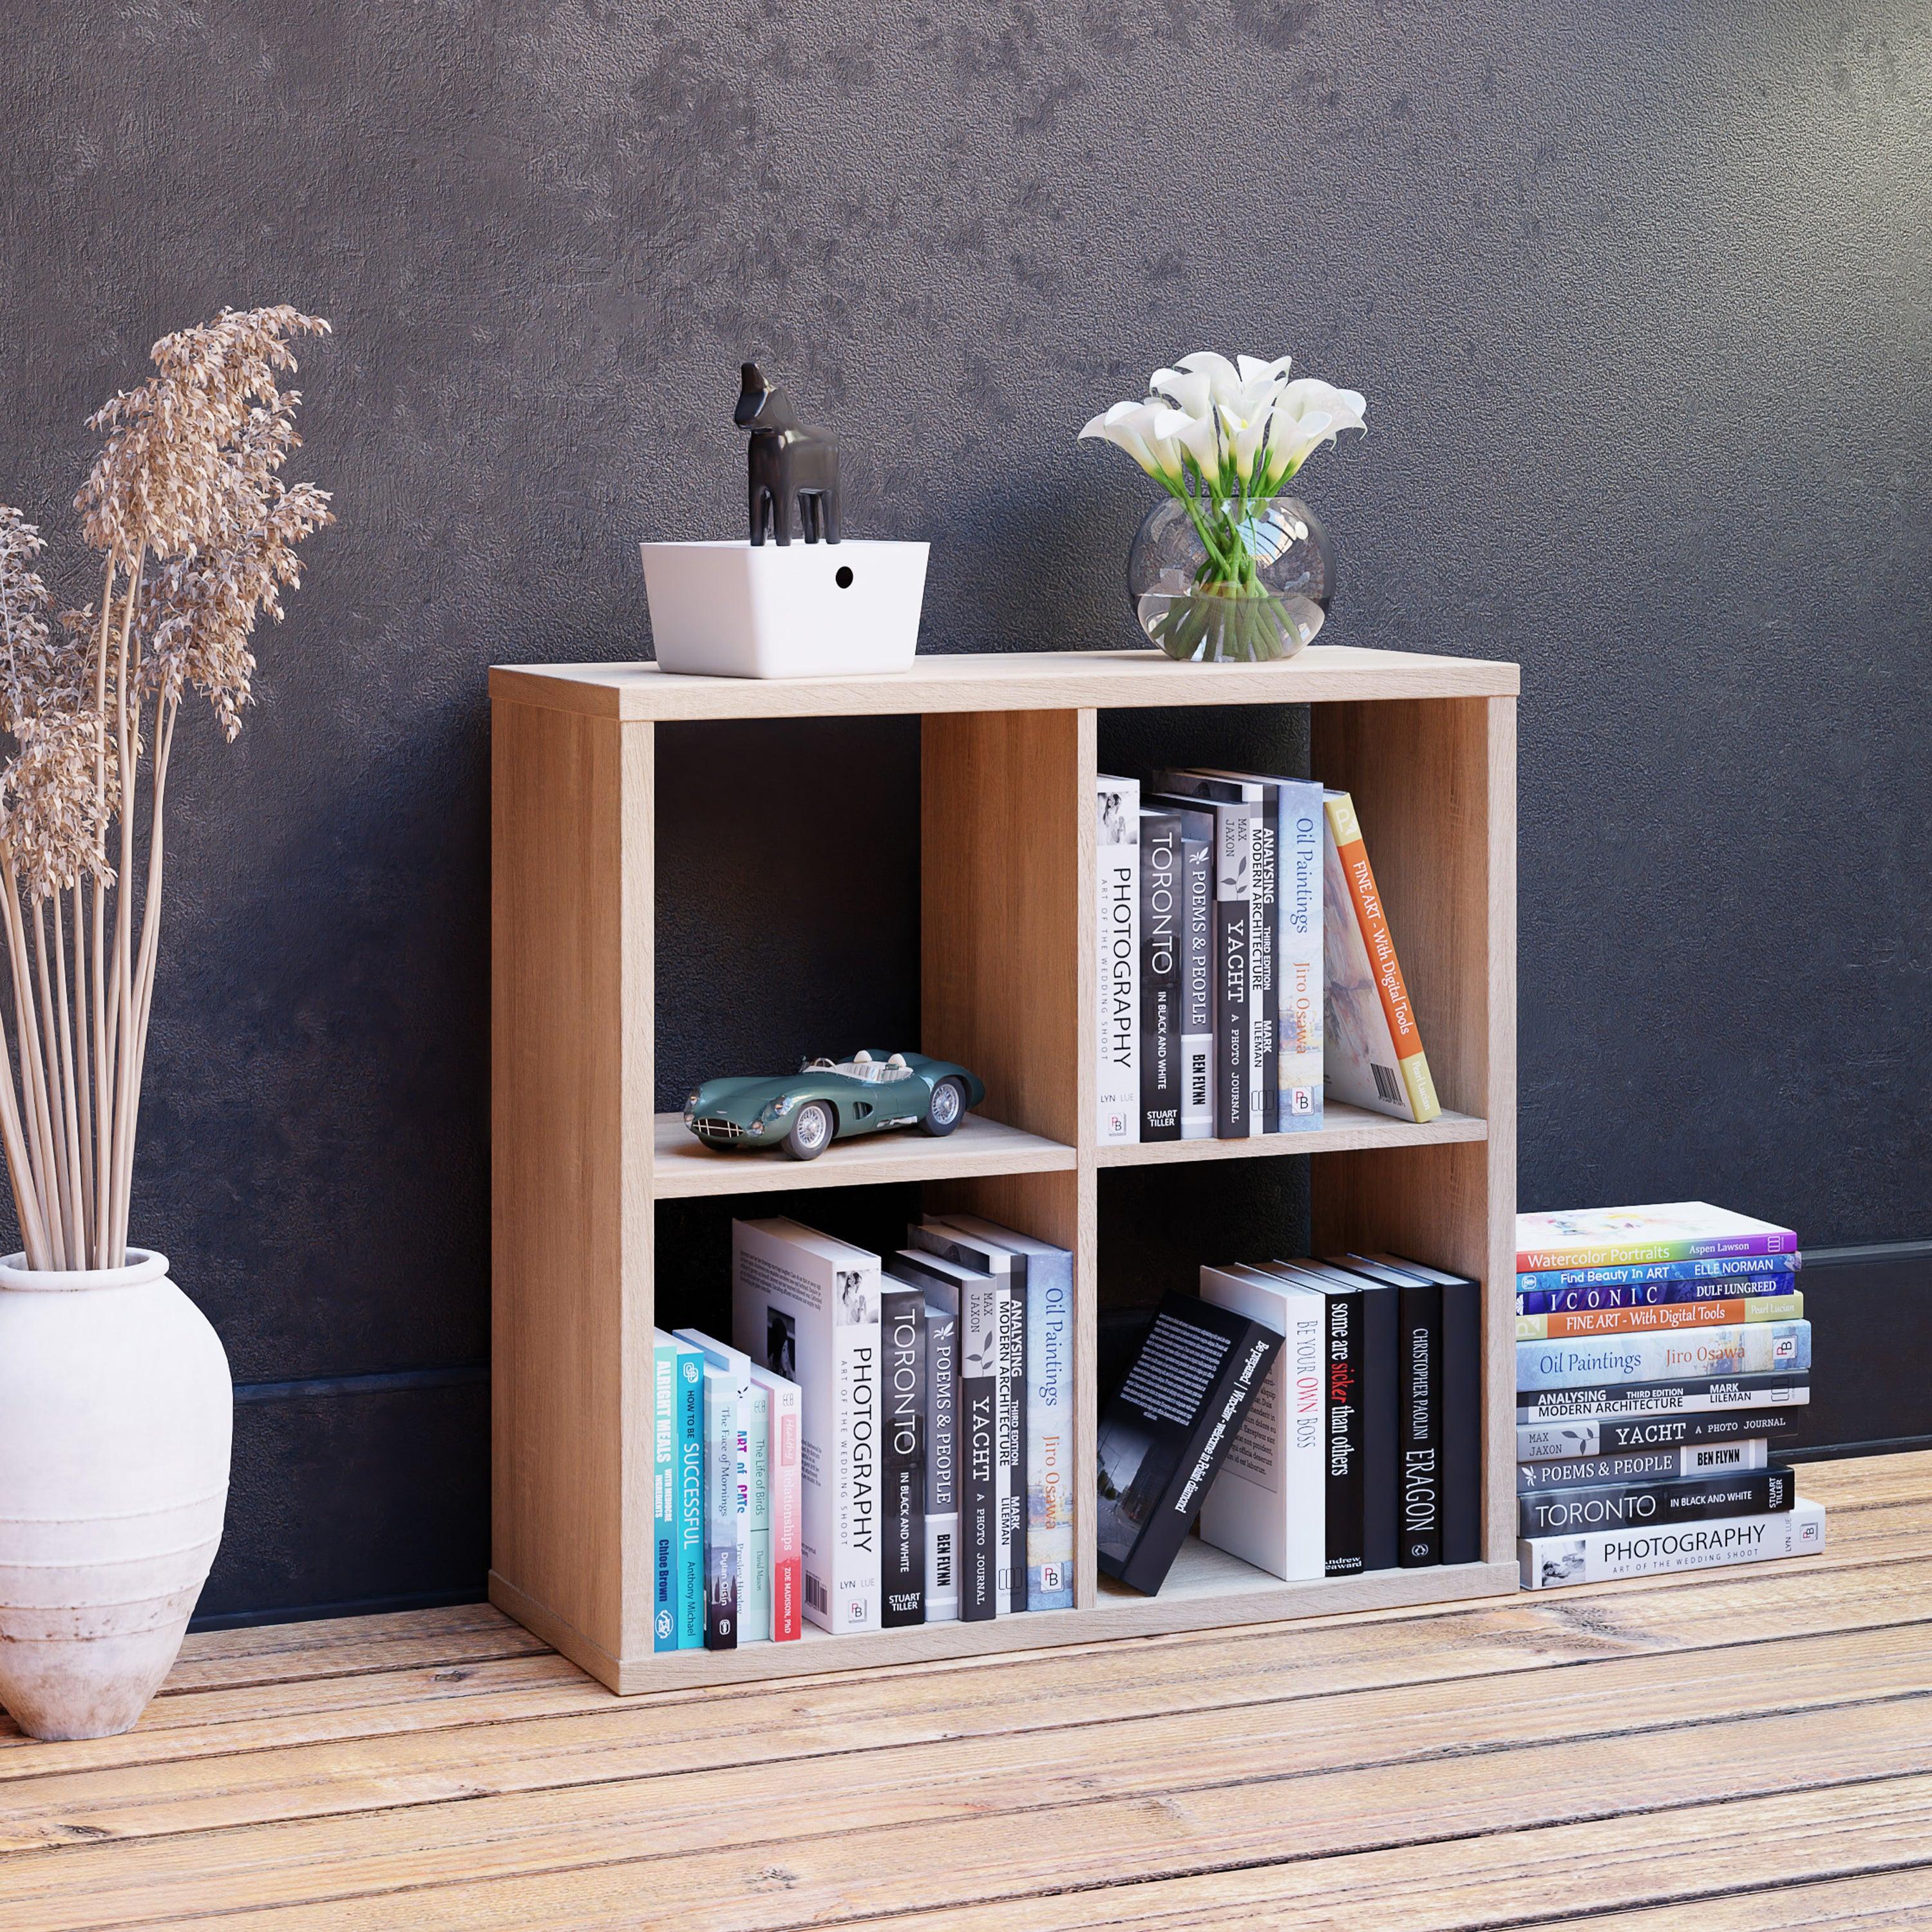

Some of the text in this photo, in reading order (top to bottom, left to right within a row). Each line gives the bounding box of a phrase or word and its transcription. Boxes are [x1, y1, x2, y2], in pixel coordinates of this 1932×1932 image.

[1226, 819, 1235, 857] JAXON
[1238, 818, 1247, 841] MAX
[1263, 828, 1274, 904] ANALYSING
[1290, 818, 1315, 934] Oil Paintings
[1151, 832, 1172, 974] TORONTO
[1253, 829, 1262, 990] MODERN ARCHITECTURE
[1192, 870, 1206, 1025] POEMS PEOPLE
[1227, 919, 1244, 1003] YACHT
[1263, 926, 1271, 990] THIRD EDITION
[1353, 860, 1414, 1035] FINE ART With Digital Tools
[1113, 868, 1131, 1068] PHOTOGRAPHY
[1293, 962, 1310, 1054] Jiro Osawa
[1158, 1004, 1166, 1090] BLACK AND WHITE
[1254, 1021, 1262, 1068] LILEMAN
[1263, 1020, 1272, 1053] MARK
[1193, 1054, 1206, 1105] BEN FLYNN
[1231, 1029, 1239, 1123] PHOTO JOURNAL
[1147, 1110, 1177, 1119] STUART
[1150, 1118, 1175, 1126] TILLER
[1528, 1246, 1670, 1268] Watercolor Portraits
[1689, 1242, 1749, 1255] Aspen Lawson
[1694, 1259, 1773, 1276] ELLE NORMAN
[1560, 1267, 1669, 1284] Find Beauty ART
[1696, 1281, 1776, 1297] DULF LUNGREED
[971, 1294, 980, 1333] JAXON
[984, 1293, 992, 1316] MAX
[1566, 1303, 1725, 1331] FINE ART With Digital Tools
[1011, 1300, 1022, 1378] ANALYSING
[1039, 1288, 1065, 1406] Oil Paintings
[1666, 1347, 1745, 1367] Jiro Osawa
[894, 1308, 916, 1455] TORONTO
[1239, 1347, 1262, 1385] prepared
[1540, 1352, 1642, 1374] Oil Paintings
[999, 1301, 1010, 1466] MODERN ARCHITECTURE
[1297, 1320, 1318, 1448] BE YOUR OWN BOSS
[1331, 1303, 1357, 1476] some are sicker than others
[1413, 1328, 1428, 1439] CHRISTOPHER PAOLINI
[1538, 1390, 1606, 1405] ANALYSING
[1626, 1388, 1683, 1399] THIRD EDITION
[1710, 1383, 1739, 1394] MARK
[1710, 1392, 1751, 1403] LILEMAN
[656, 1361, 671, 1463] ALRIGHT MEALS
[936, 1346, 951, 1504] POEMS PEOPLE
[1539, 1397, 1683, 1417] MODERN ARCHITECTURE
[1708, 1417, 1786, 1432] PHOTO JOURNAL
[784, 1419, 795, 1459] Healthy
[853, 1348, 871, 1552] PHOTOGRAPHY
[972, 1396, 990, 1481] YACHT
[1204, 1422, 1226, 1460] welcome
[1244, 1425, 1267, 1441] Excepteur
[1529, 1432, 1549, 1443] MAX
[1530, 1444, 1562, 1456] JAXON
[1615, 1423, 1686, 1445] YACHT
[719, 1431, 730, 1517] Face Mornings
[1190, 1460, 1210, 1486] Polish
[1253, 1452, 1273, 1466] deserunt
[1541, 1455, 1672, 1482] POEMS PEOPLE
[1697, 1449, 1739, 1466] BEN FLYNN
[684, 1443, 699, 1550] SUCCESSFUL
[755, 1439, 765, 1516] The Birds
[1042, 1435, 1060, 1530] Jiro Osawa
[1175, 1480, 1198, 1513] diamond
[1406, 1448, 1435, 1531] ERAGON
[664, 1484, 672, 1522] MEDIOCRE
[781, 1468, 795, 1551] Relationships
[1010, 1496, 1020, 1530] MARK
[1535, 1495, 1656, 1528] TORONTO
[1681, 1491, 1752, 1506] BLACK AND WHITE
[900, 1485, 909, 1573] BLACK AND WHITE
[1001, 1497, 1010, 1545] LILEMAN
[937, 1534, 951, 1586] BEN FLYNN
[976, 1508, 985, 1605] PHOTO JOURNAL
[1604, 1524, 1766, 1562] PHOTOGRAPHY
[1613, 1548, 1759, 1573] ART THE WEDDING SHOOT
[659, 1539, 669, 1602] Chloe Brown
[719, 1552, 728, 1579] Dylan
[1325, 1560, 1362, 1569] eaward
[685, 1561, 696, 1636] Anthony Michael
[889, 1593, 920, 1604] STUART
[892, 1602, 918, 1611] TILLER
